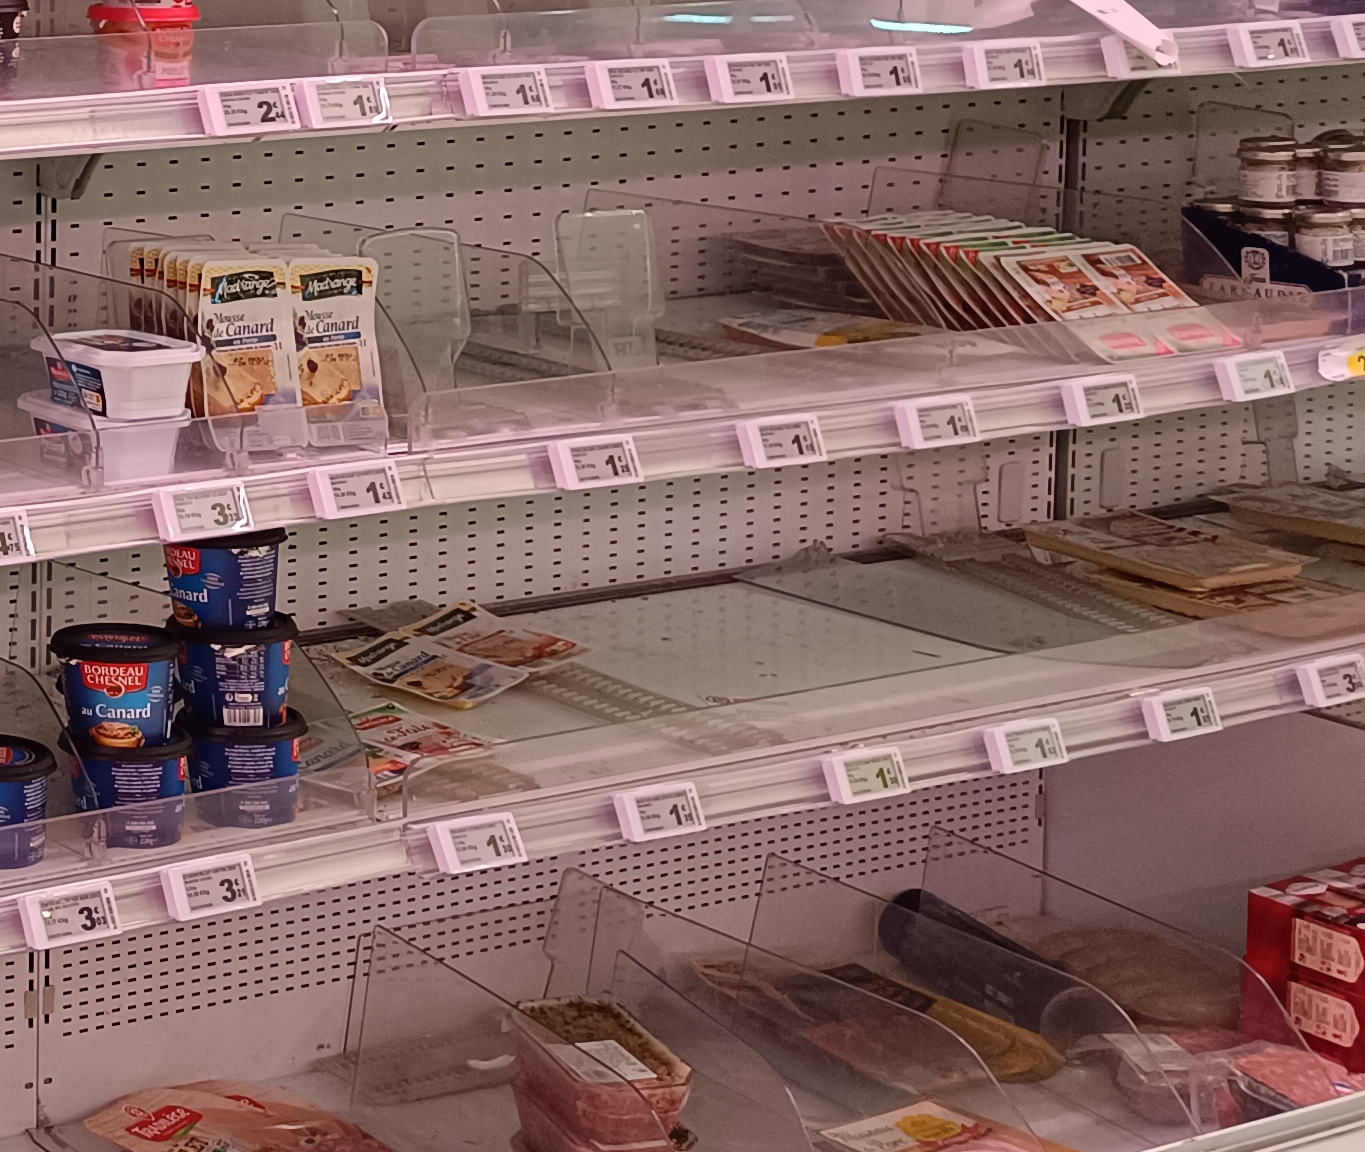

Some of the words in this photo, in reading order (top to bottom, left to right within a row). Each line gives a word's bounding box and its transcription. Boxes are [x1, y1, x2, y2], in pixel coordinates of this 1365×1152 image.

[214, 311, 245, 326] Mousse
[305, 309, 334, 323] Mousse
[226, 317, 275, 337] Canard
[316, 315, 360, 333] Canard
[83, 663, 145, 678] BORDEAU
[86, 675, 143, 688] CHESNEL
[81, 706, 93, 716] au
[95, 702, 152, 720] Canard
